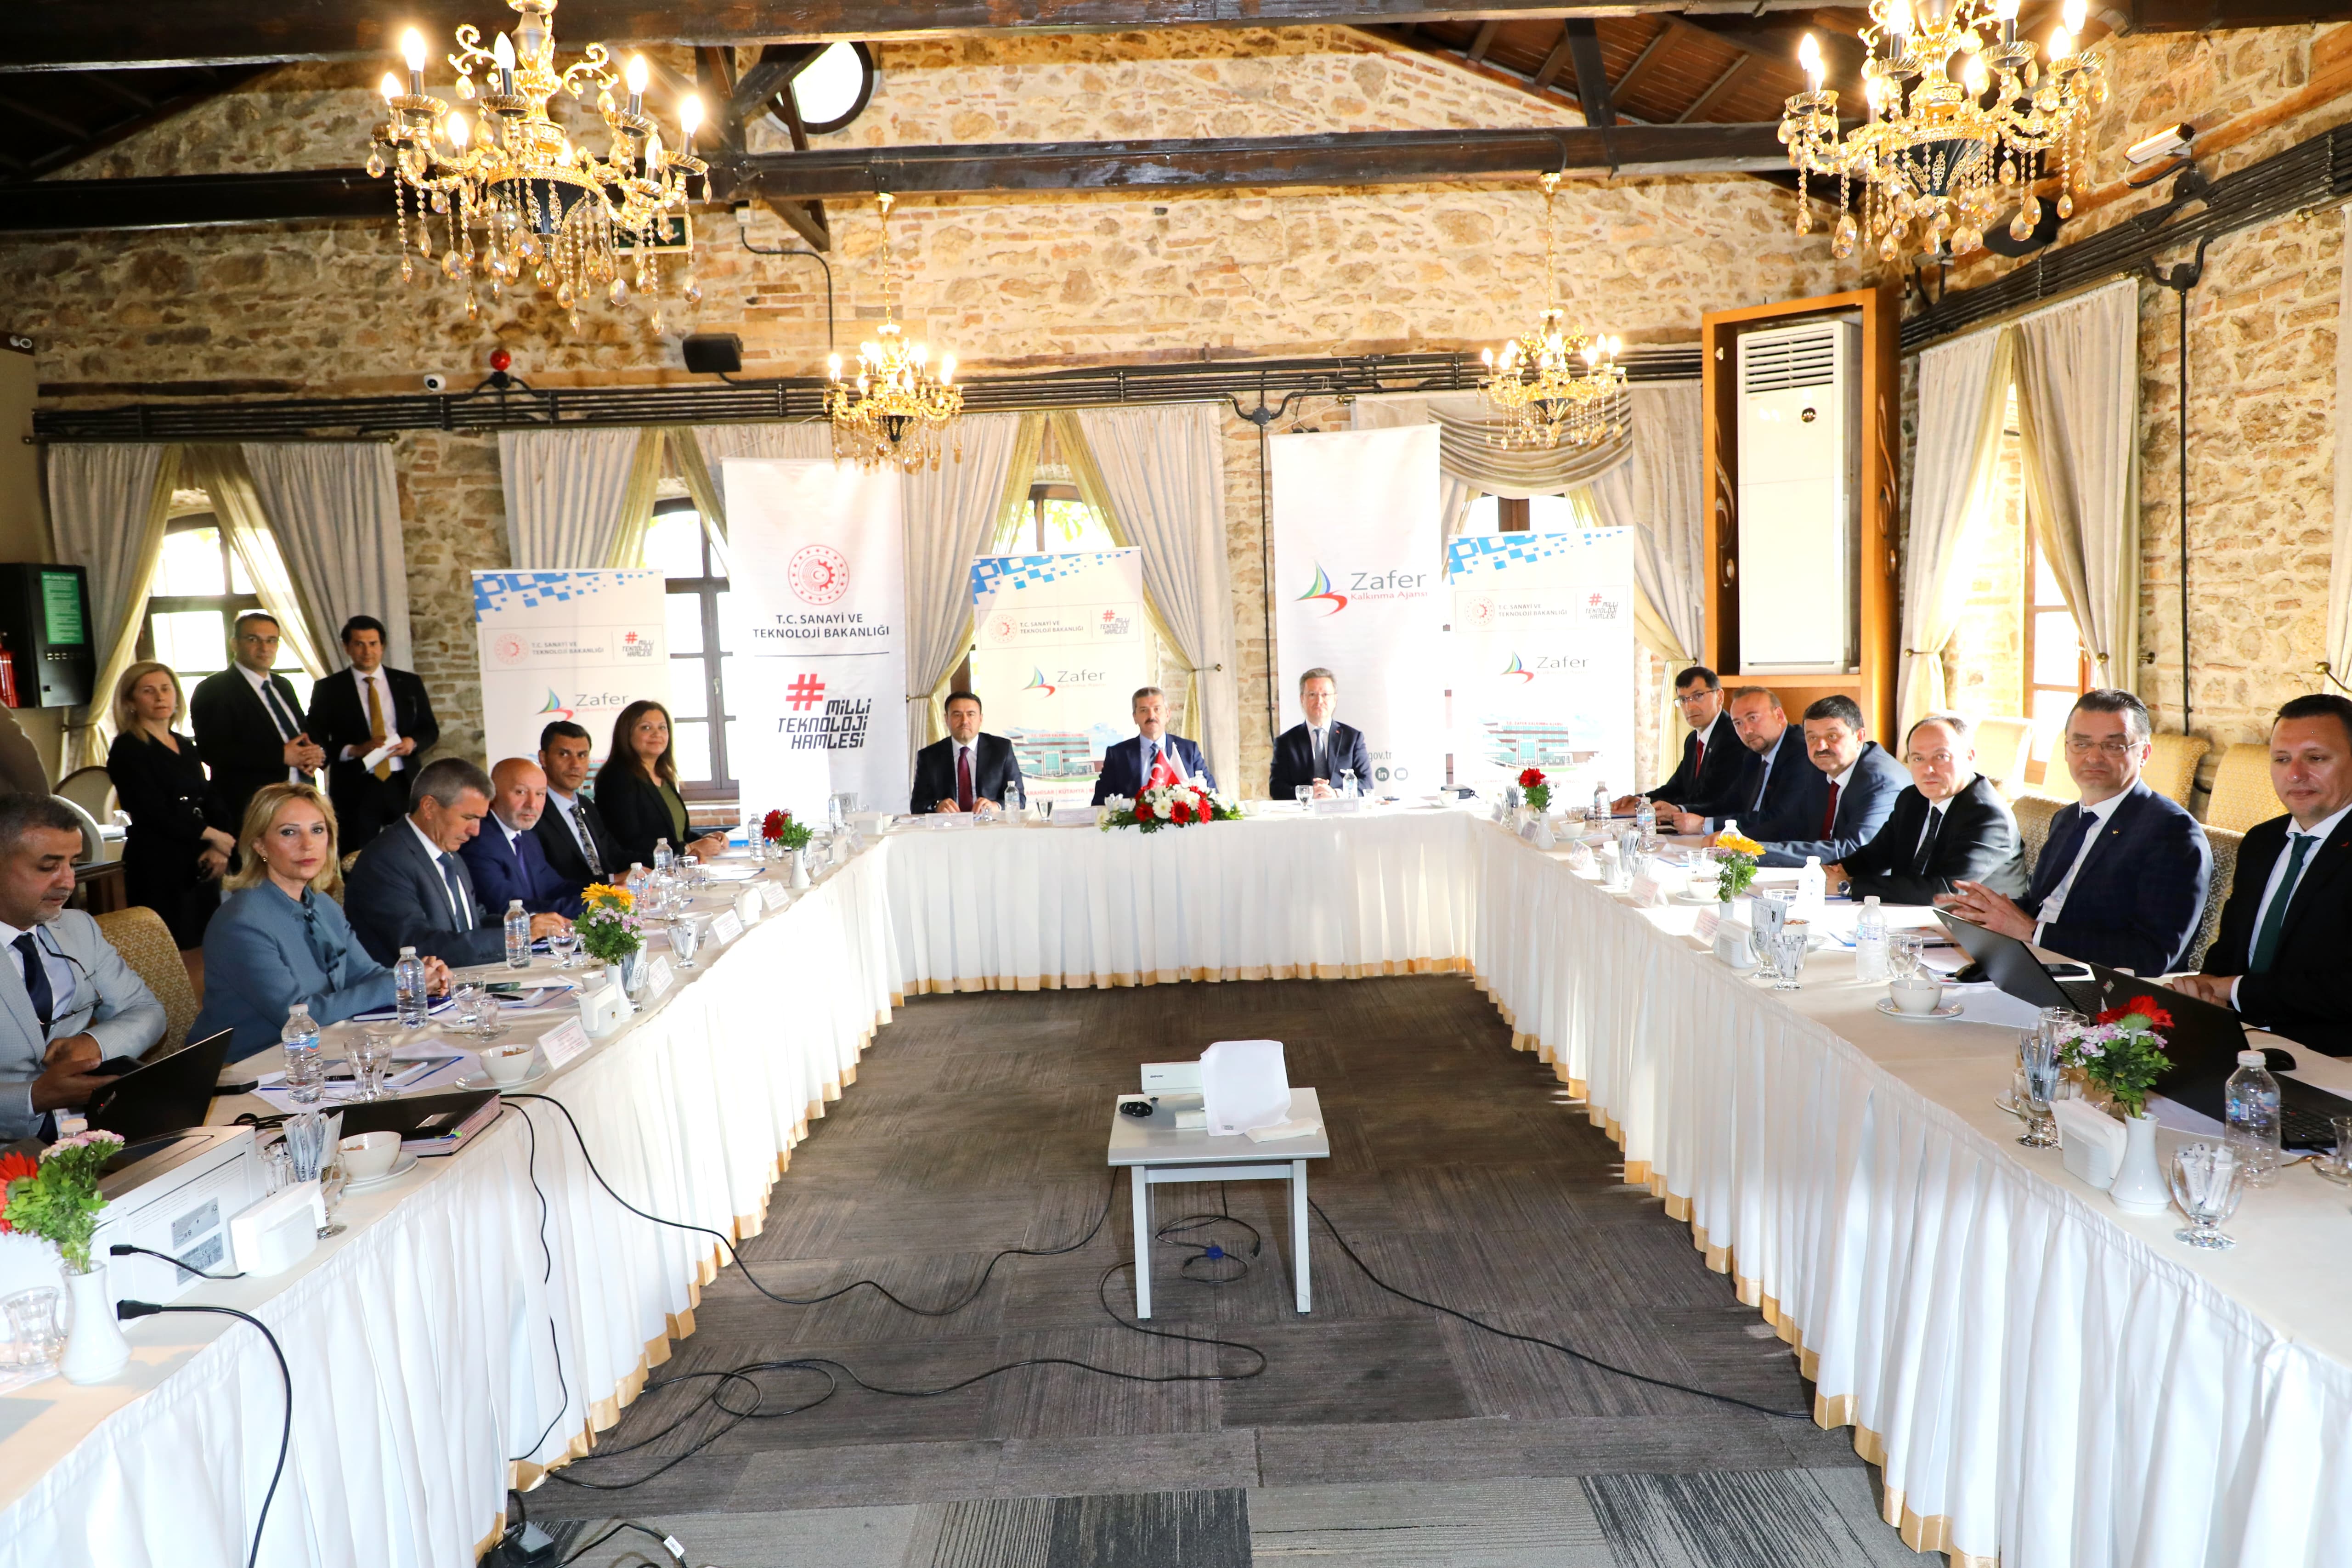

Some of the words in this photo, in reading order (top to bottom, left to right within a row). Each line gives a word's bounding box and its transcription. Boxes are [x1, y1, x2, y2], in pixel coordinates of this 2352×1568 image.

[1351, 570, 1426, 590] Zafer
[1397, 591, 1427, 600] Ajansı
[776, 615, 797, 624] T.C.
[800, 612, 844, 624] SANAYİ
[848, 614, 863, 623] VE
[753, 627, 820, 638] TEKNOLOJİ
[824, 624, 889, 638] BAKANLIĞI
[1537, 655, 1589, 668] Zafer
[1057, 669, 1106, 682] Zafer
[575, 692, 629, 707] Zafer
[1368, 750, 1392, 762] gov.tr
